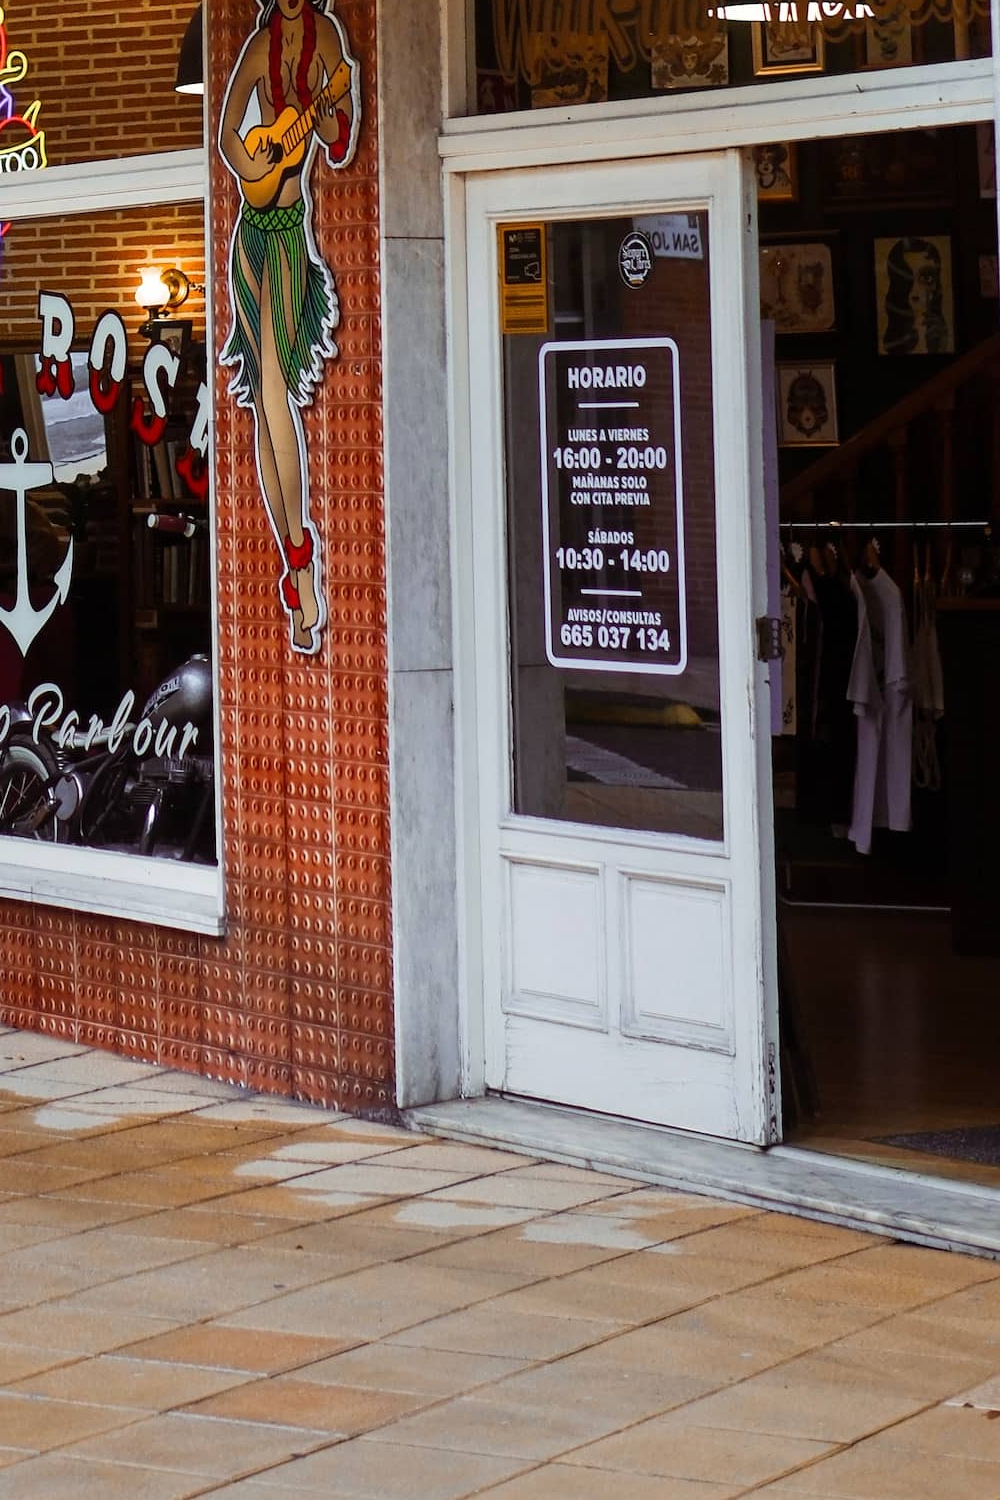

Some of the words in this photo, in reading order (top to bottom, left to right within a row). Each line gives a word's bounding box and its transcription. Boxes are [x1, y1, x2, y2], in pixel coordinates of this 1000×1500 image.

[567, 365, 646, 389] HORARIO
[567, 429, 597, 442] LUNES
[599, 429, 607, 441] A
[608, 428, 649, 441] VIERNES
[553, 446, 600, 470] 16:00
[616, 446, 667, 470] 20:00
[572, 472, 619, 489] MAÑANAS
[621, 476, 647, 489] SOLO
[570, 491, 590, 505] CON
[592, 492, 613, 505] CITA
[614, 492, 650, 506] PREVIA
[588, 527, 634, 545] SÁBADOS
[556, 547, 604, 570] 10:30
[620, 549, 670, 573] 14:00
[567, 608, 662, 626] AVISOS/CONSULTAS
[560, 623, 593, 647] 665
[597, 625, 631, 649] 037
[636, 627, 671, 651] 134
[27, 681, 200, 761] Parlour
